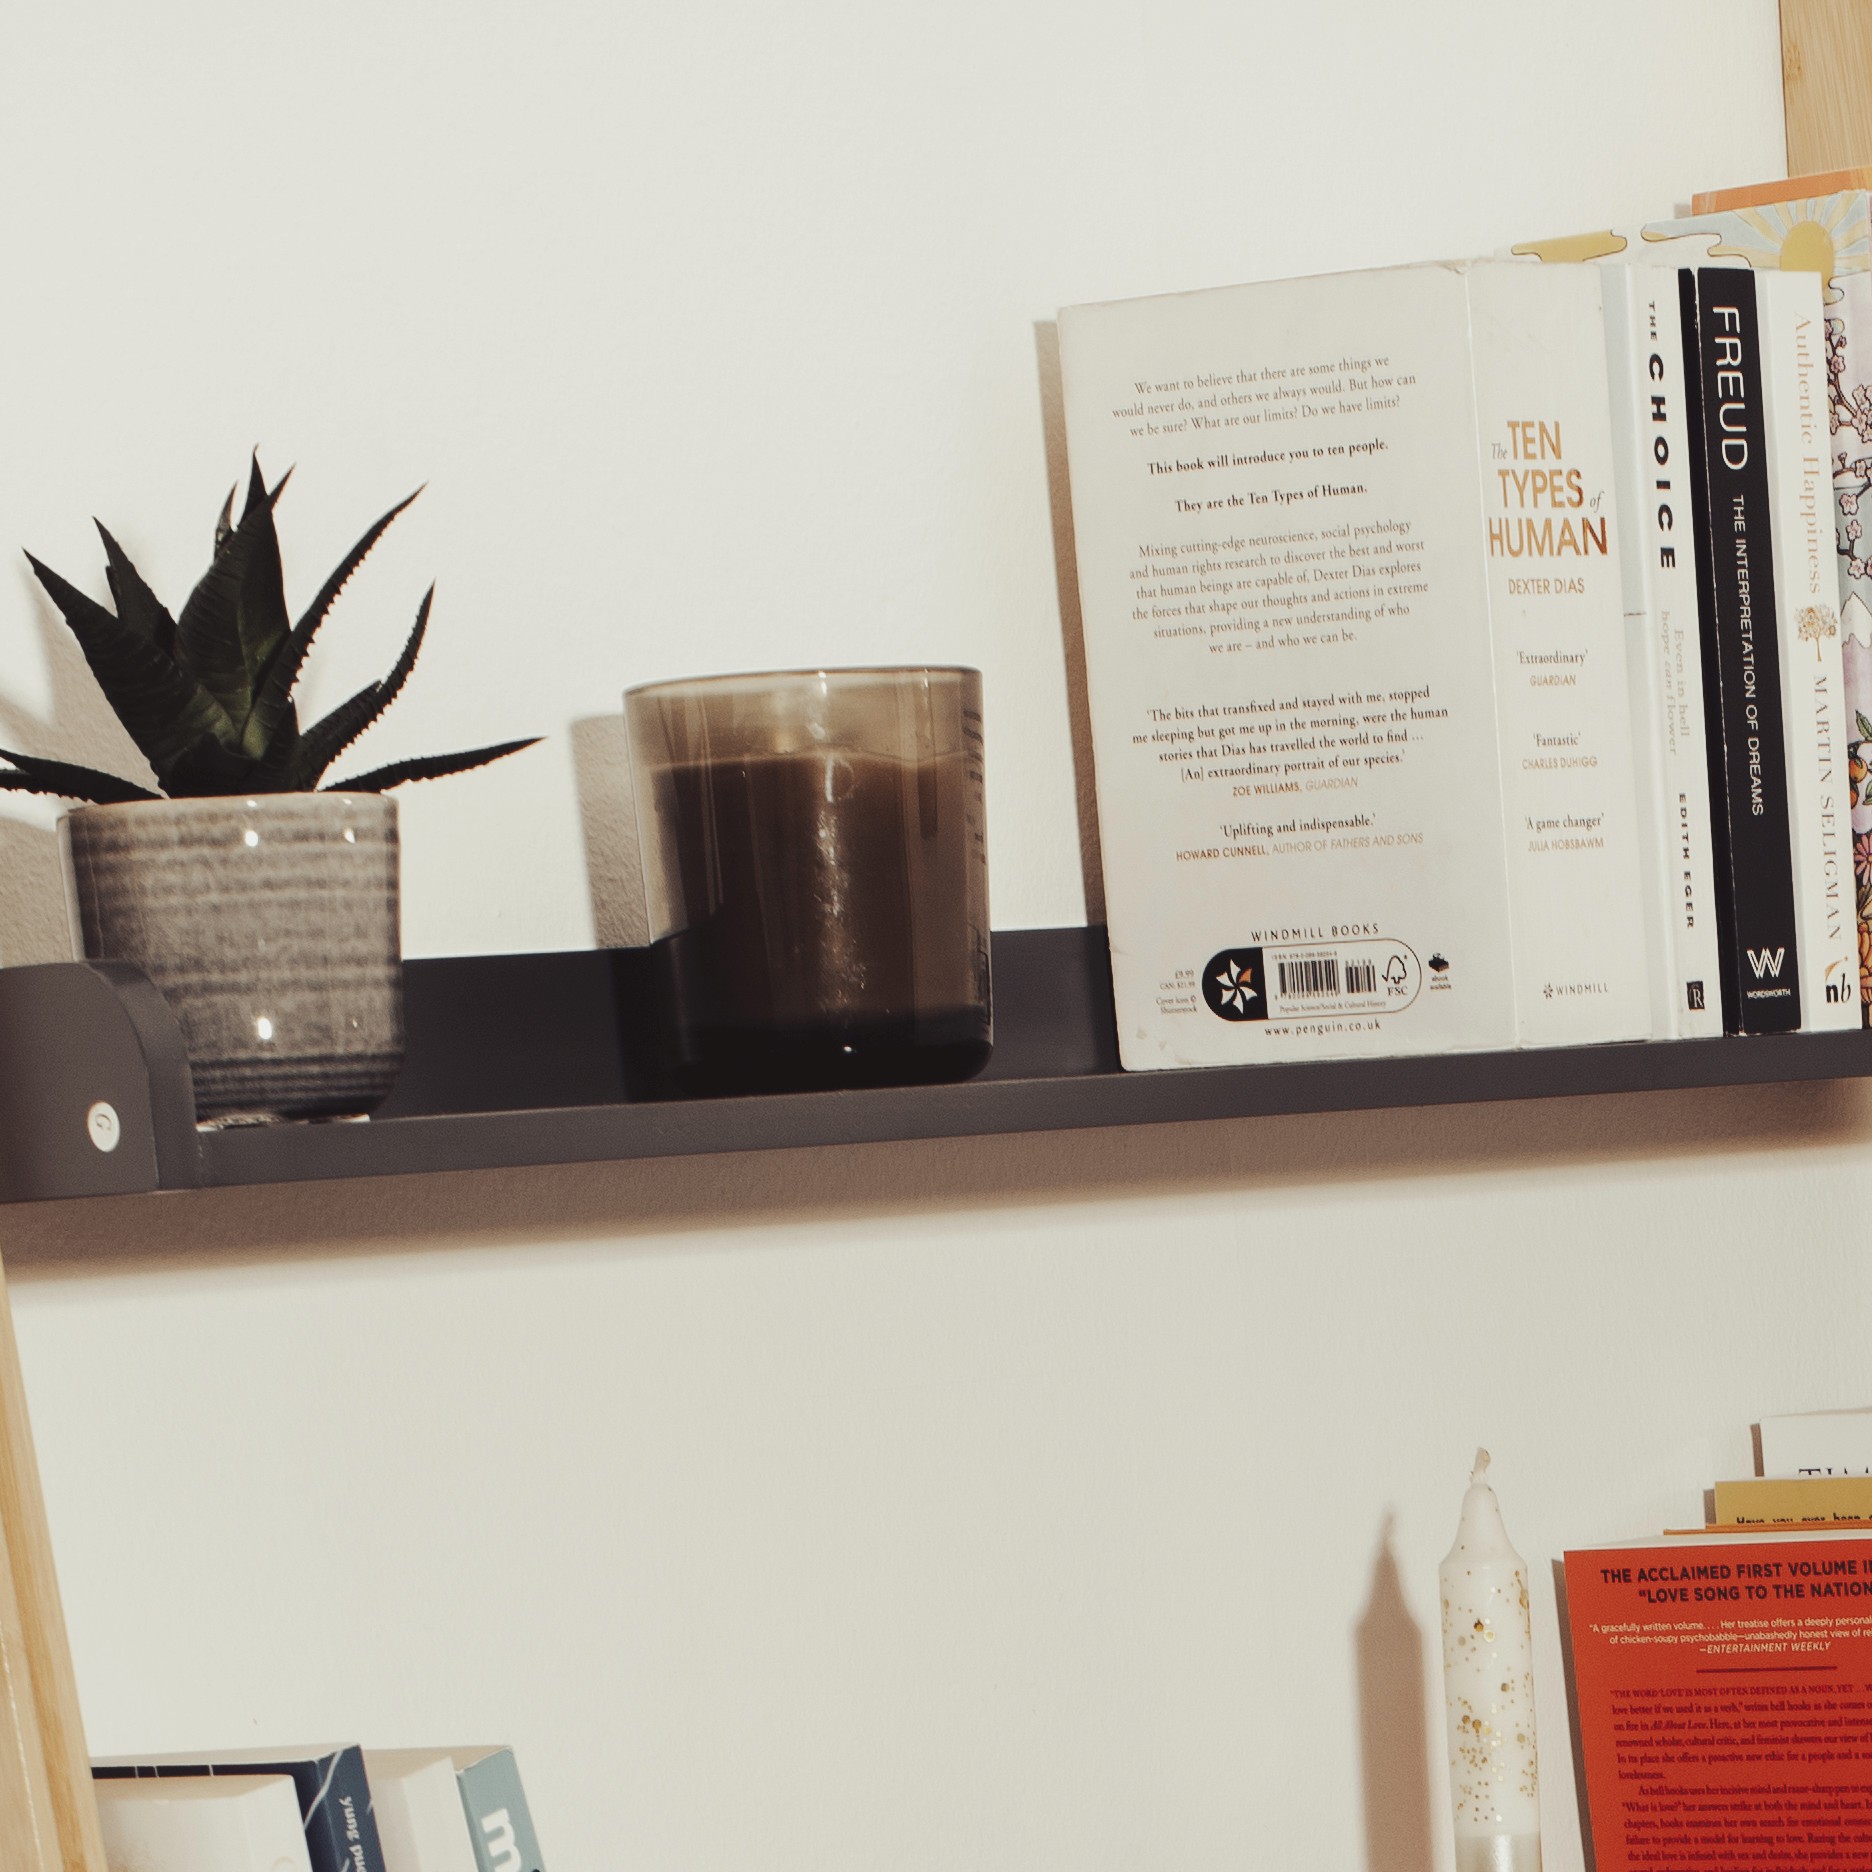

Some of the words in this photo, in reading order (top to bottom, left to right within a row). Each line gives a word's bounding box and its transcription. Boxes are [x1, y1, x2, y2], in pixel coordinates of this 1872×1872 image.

[1649, 300, 1658, 342] THE
[1712, 306, 1748, 471] FREUD
[1794, 312, 1819, 444] Authentic
[1147, 462, 1172, 475] This
[1176, 458, 1204, 471] book
[1208, 456, 1229, 468] will
[1232, 451, 1285, 466] introduce
[1289, 449, 1309, 462] you
[1312, 446, 1324, 457] to
[1328, 445, 1345, 455] ten
[1349, 438, 1388, 456] people.
[1491, 442, 1508, 460] The
[1507, 420, 1562, 460] TEN
[1649, 353, 1676, 568] CHOICE
[1175, 499, 1202, 513] They
[1207, 497, 1224, 508] are
[1227, 495, 1244, 506] the
[1248, 492, 1268, 504] Ten
[1272, 489, 1304, 504] Types
[1307, 485, 1319, 498] of
[1322, 483, 1367, 496] Human.
[1498, 468, 1584, 509] TYPES
[1589, 491, 1605, 513] of
[1732, 494, 1746, 532] THE
[1800, 456, 1822, 594] Happiness
[1489, 516, 1608, 557] HUMAN
[1508, 578, 1550, 595] DEXTER
[1554, 578, 1584, 594] DIAS
[1661, 610, 1673, 657] hope
[1735, 539, 1758, 699] INTERPRETATION
[1674, 629, 1683, 676] Even
[1530, 674, 1576, 686] GUARDIAN
[1665, 661, 1673, 691] can
[1677, 681, 1686, 698] in
[1666, 695, 1676, 755] flower
[1679, 702, 1691, 738] hell
[1746, 706, 1758, 731] OF
[1813, 675, 1833, 784] MARTIN
[1523, 757, 1558, 769] CHARLES
[1560, 756, 1598, 768] DUHIGG
[1746, 736, 1763, 817] DREAMS
[1277, 820, 1296, 833] and
[1528, 839, 1549, 851] JULIA
[1552, 837, 1604, 851] HOBSBAWM
[1536, 818, 1560, 833] game
[1679, 793, 1690, 860] EDITH
[1820, 795, 1841, 940] SELIGMAN
[1684, 871, 1694, 929] EGER
[1251, 927, 1324, 942] WINDMILL
[1331, 923, 1379, 936] BOOKS
[1387, 986, 1409, 996] FSC
[1556, 983, 1609, 996] WINDMILL
[1746, 987, 1791, 999] WORDSWORTH
[1265, 1020, 1381, 1037] www.penguin.co.uk
[1601, 1568, 1632, 1584] THE
[1637, 1564, 1731, 1582] ACCLAIMED
[1737, 1562, 1782, 1579] FIRST
[1788, 1560, 1857, 1577] VOLUME
[1695, 1585, 1740, 1602] SONG
[1745, 1585, 1768, 1600] TO
[1772, 1584, 1805, 1599] THE
[338, 1795, 360, 1841] yung
